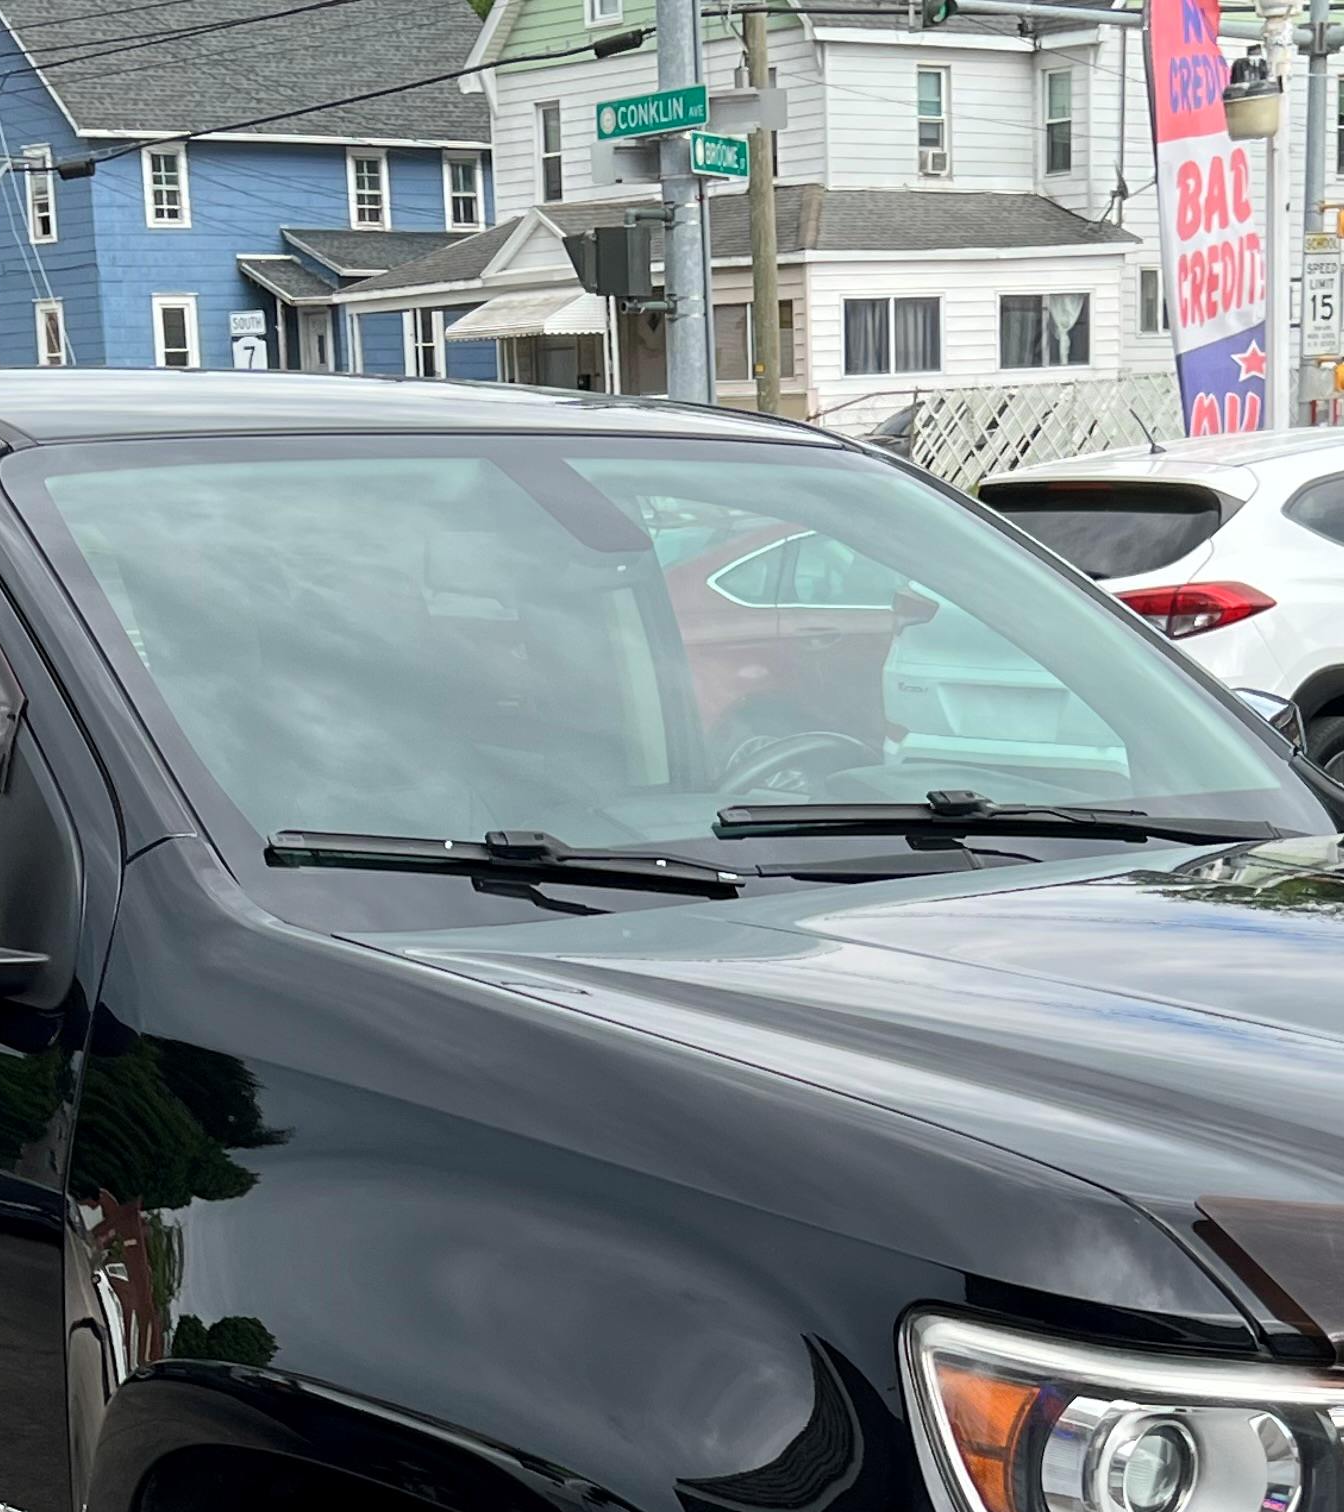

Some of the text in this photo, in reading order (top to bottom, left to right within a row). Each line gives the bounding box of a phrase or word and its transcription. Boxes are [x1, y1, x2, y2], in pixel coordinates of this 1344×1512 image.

[617, 97, 705, 130] CONKLIN AVE
[1306, 262, 1338, 275] SPEED
[1309, 278, 1335, 291] LIMIT
[1311, 294, 1334, 321] 15
[232, 316, 262, 330] SOUTH
[244, 345, 255, 369] 7
